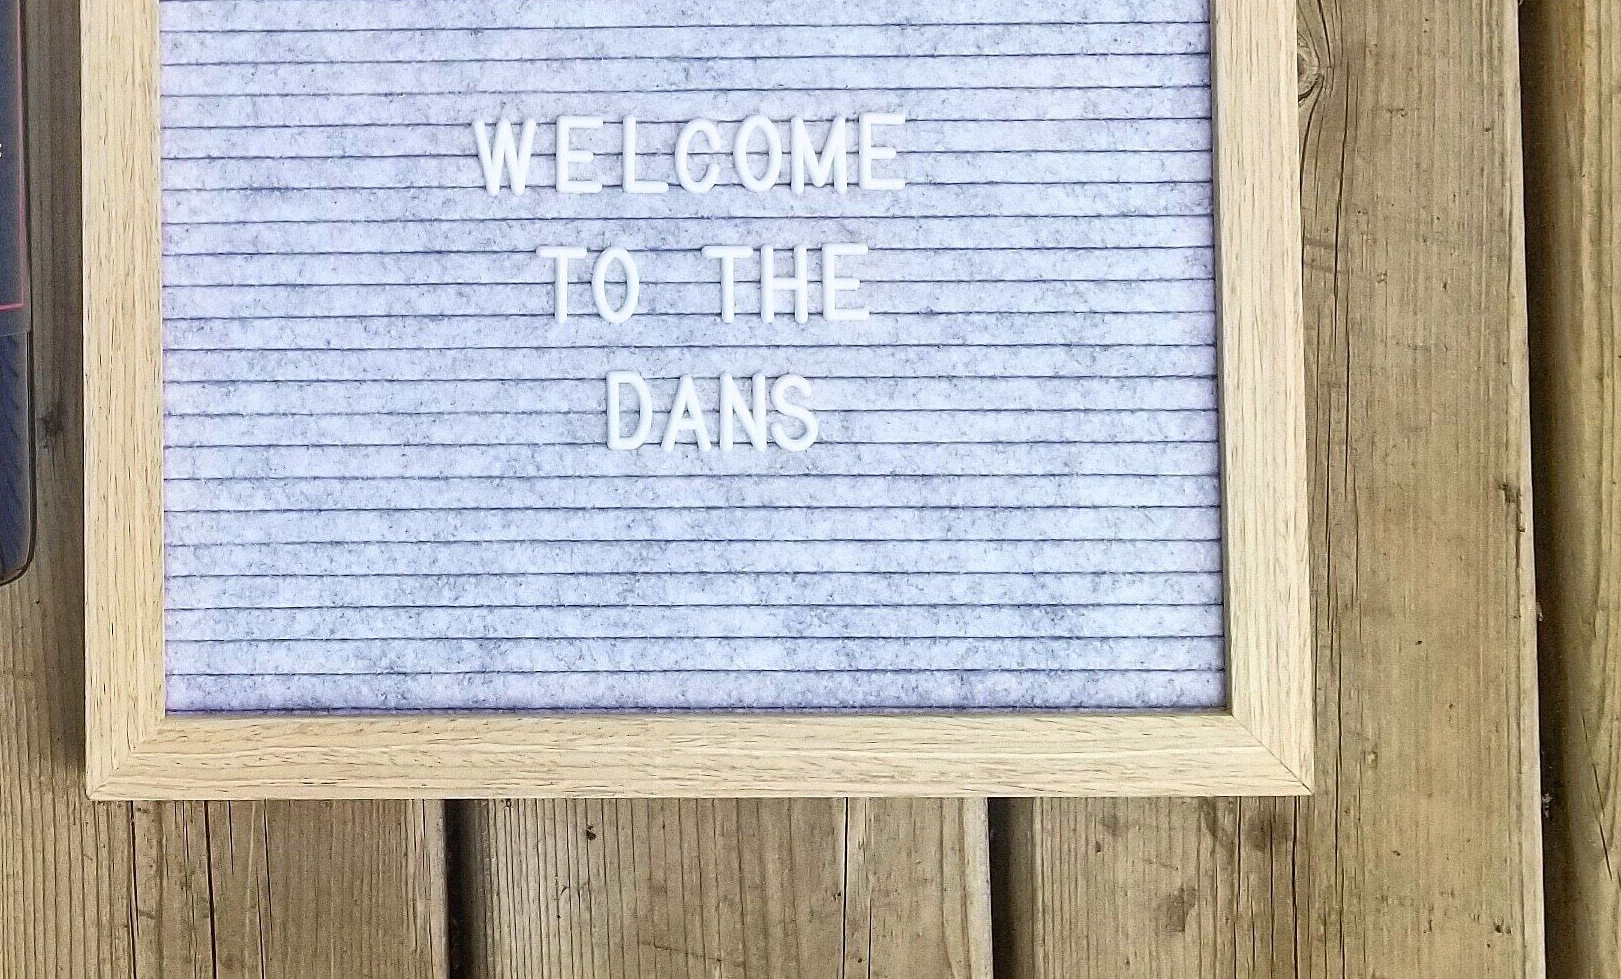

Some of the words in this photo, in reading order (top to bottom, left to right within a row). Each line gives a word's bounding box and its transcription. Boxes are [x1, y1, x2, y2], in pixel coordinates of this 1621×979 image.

[472, 112, 907, 196] WELCOME
[536, 244, 640, 325] TO
[701, 243, 870, 325] THE
[606, 370, 820, 453] DANS
